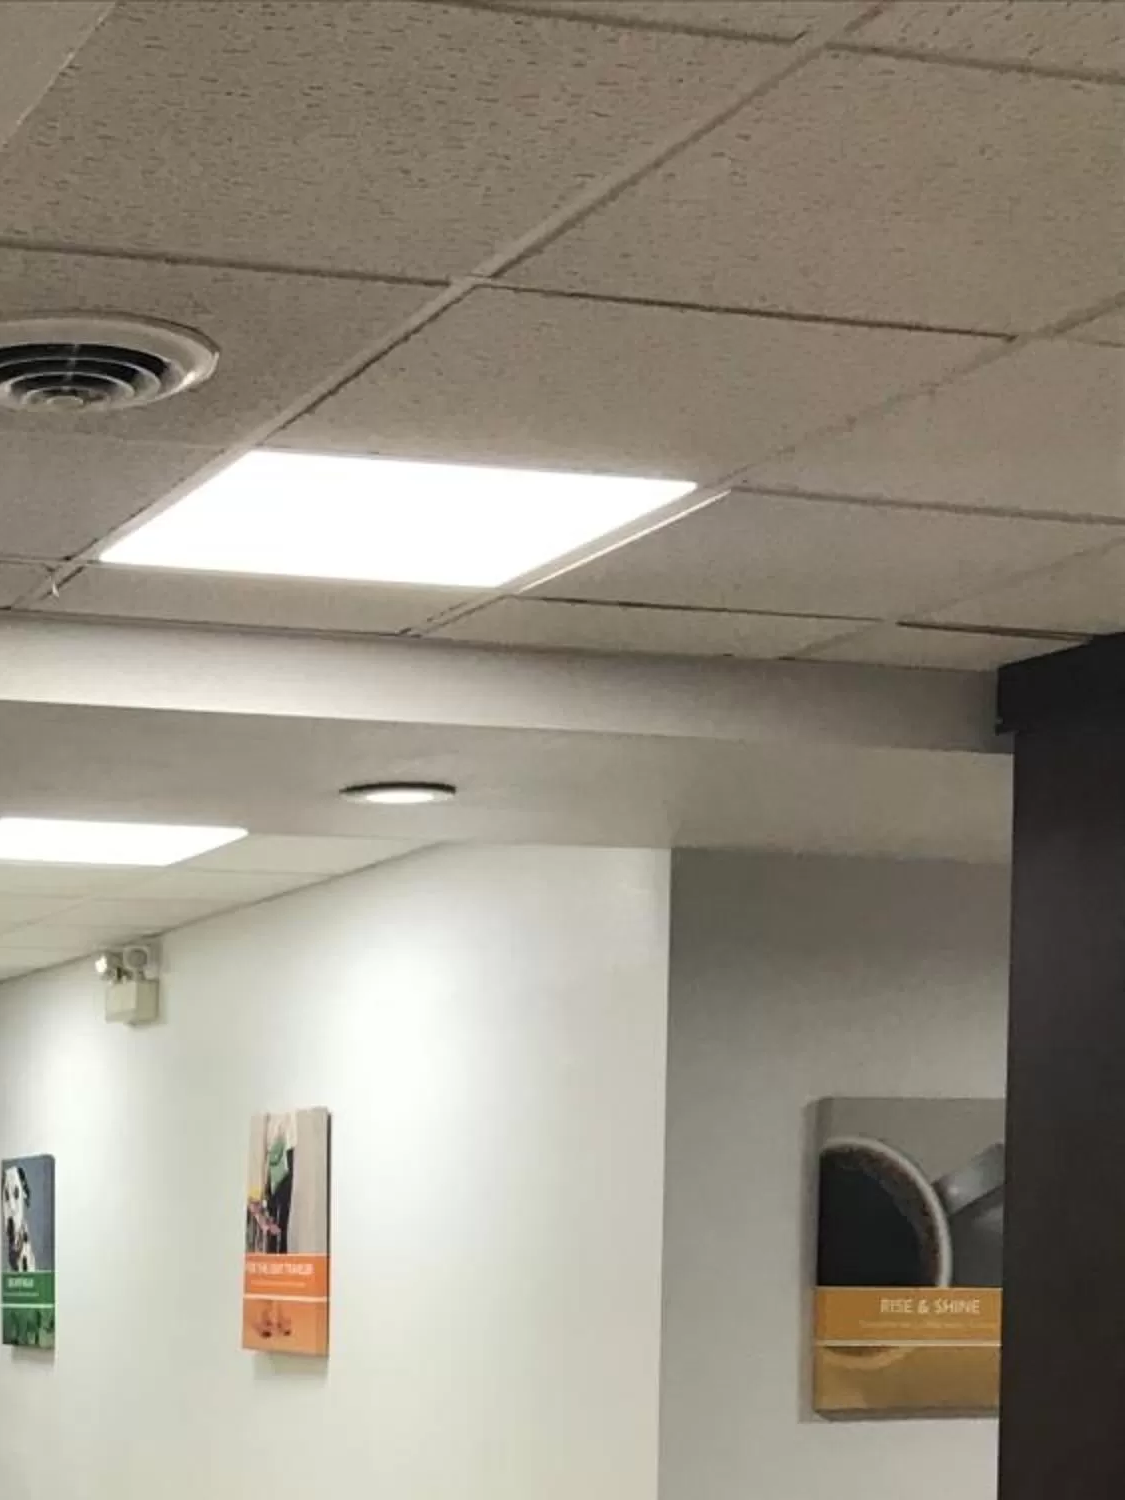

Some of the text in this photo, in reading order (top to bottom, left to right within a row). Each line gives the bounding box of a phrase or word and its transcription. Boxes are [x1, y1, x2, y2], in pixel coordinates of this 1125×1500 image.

[879, 1298, 980, 1315] RISE & SHINE
